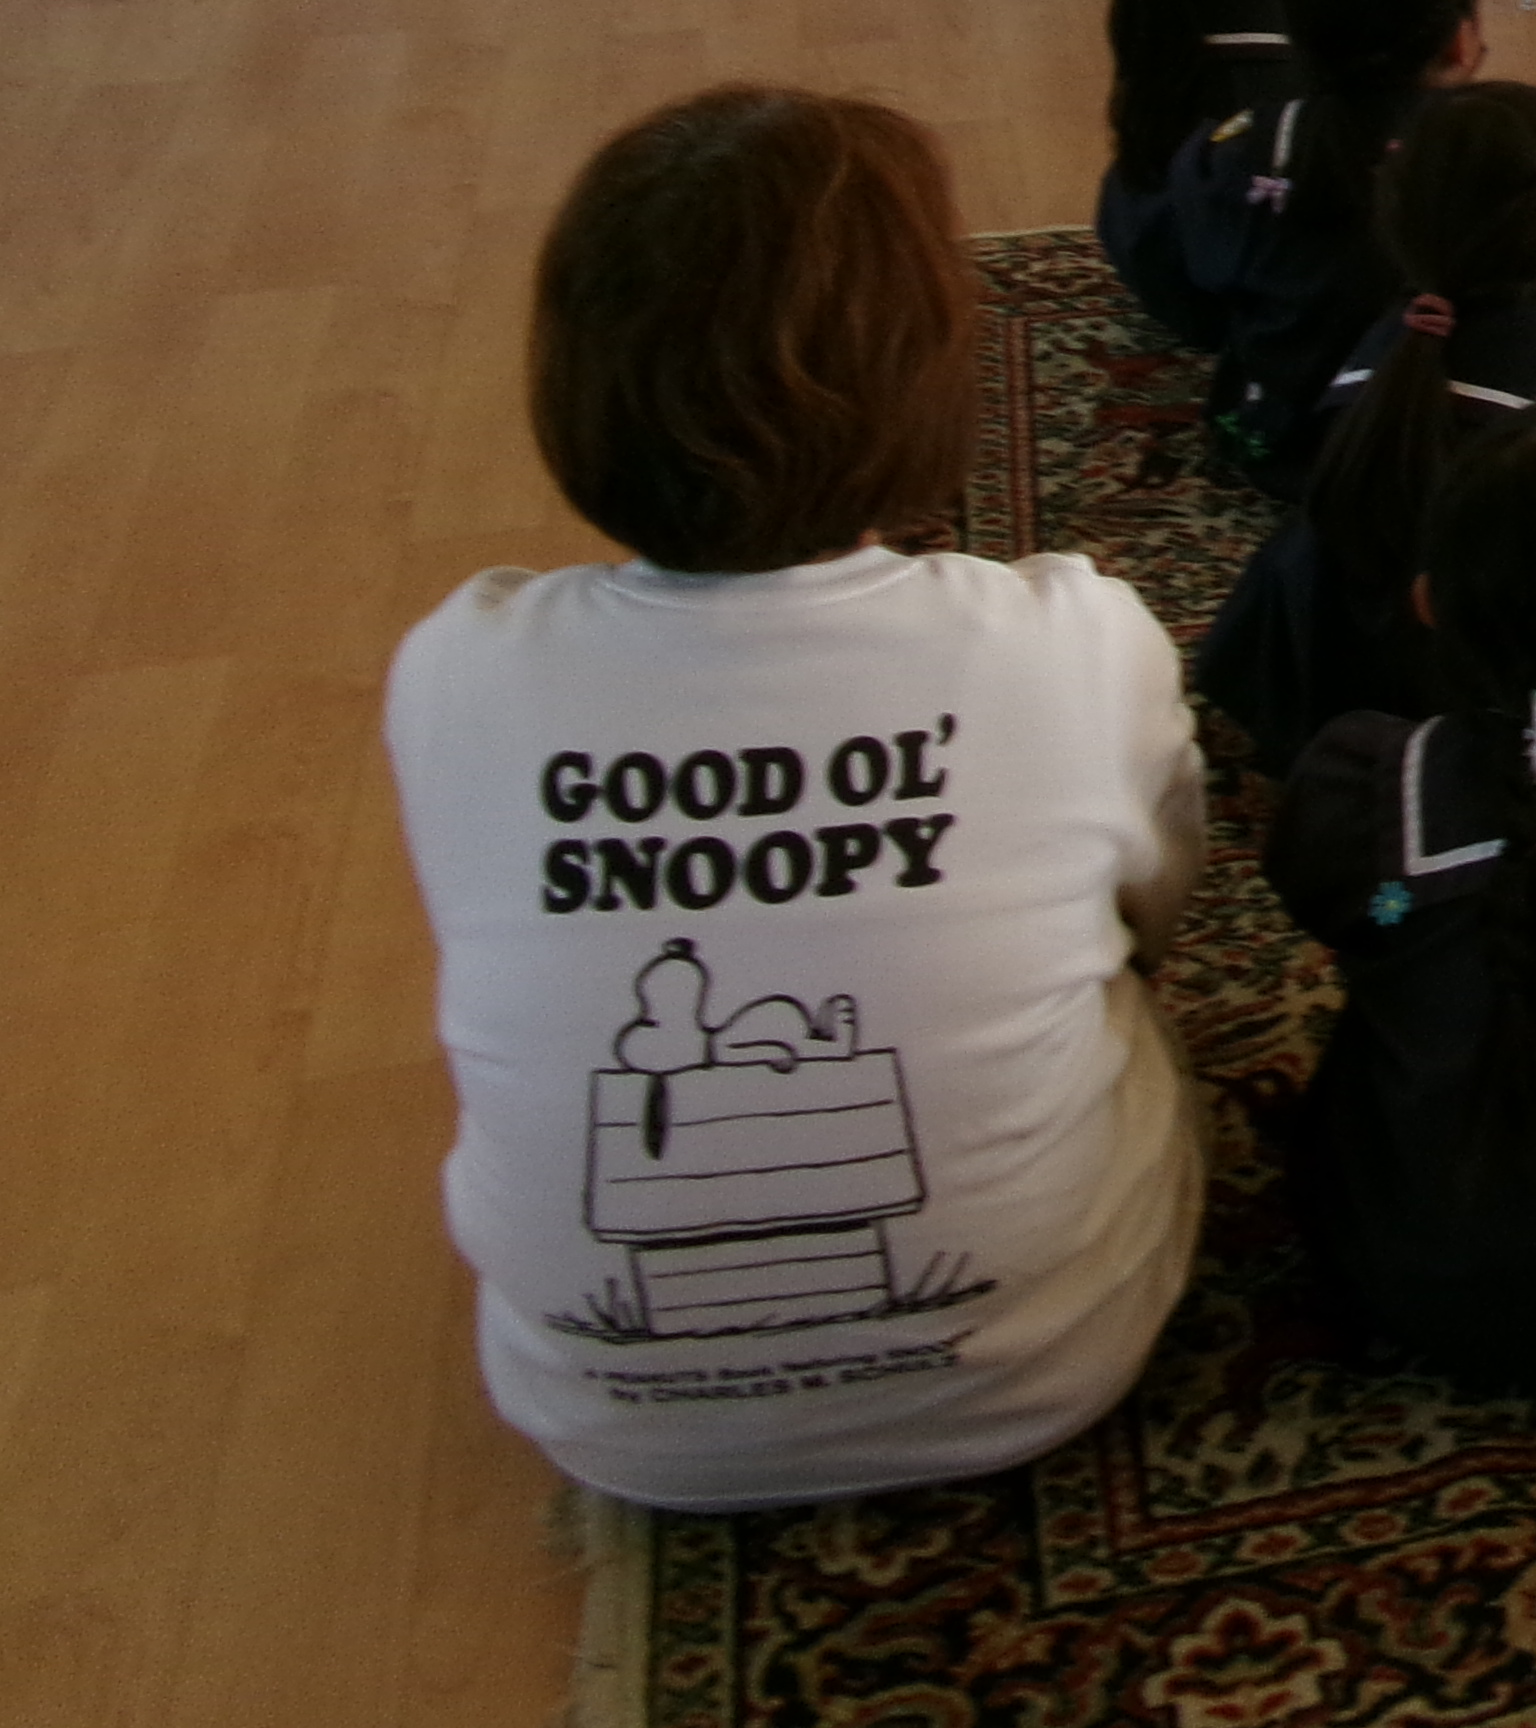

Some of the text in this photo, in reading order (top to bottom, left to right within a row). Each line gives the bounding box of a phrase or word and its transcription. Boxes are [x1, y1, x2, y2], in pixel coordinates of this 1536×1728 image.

[541, 713, 956, 824] GOOD OL'
[543, 813, 955, 915] SNOOPY
